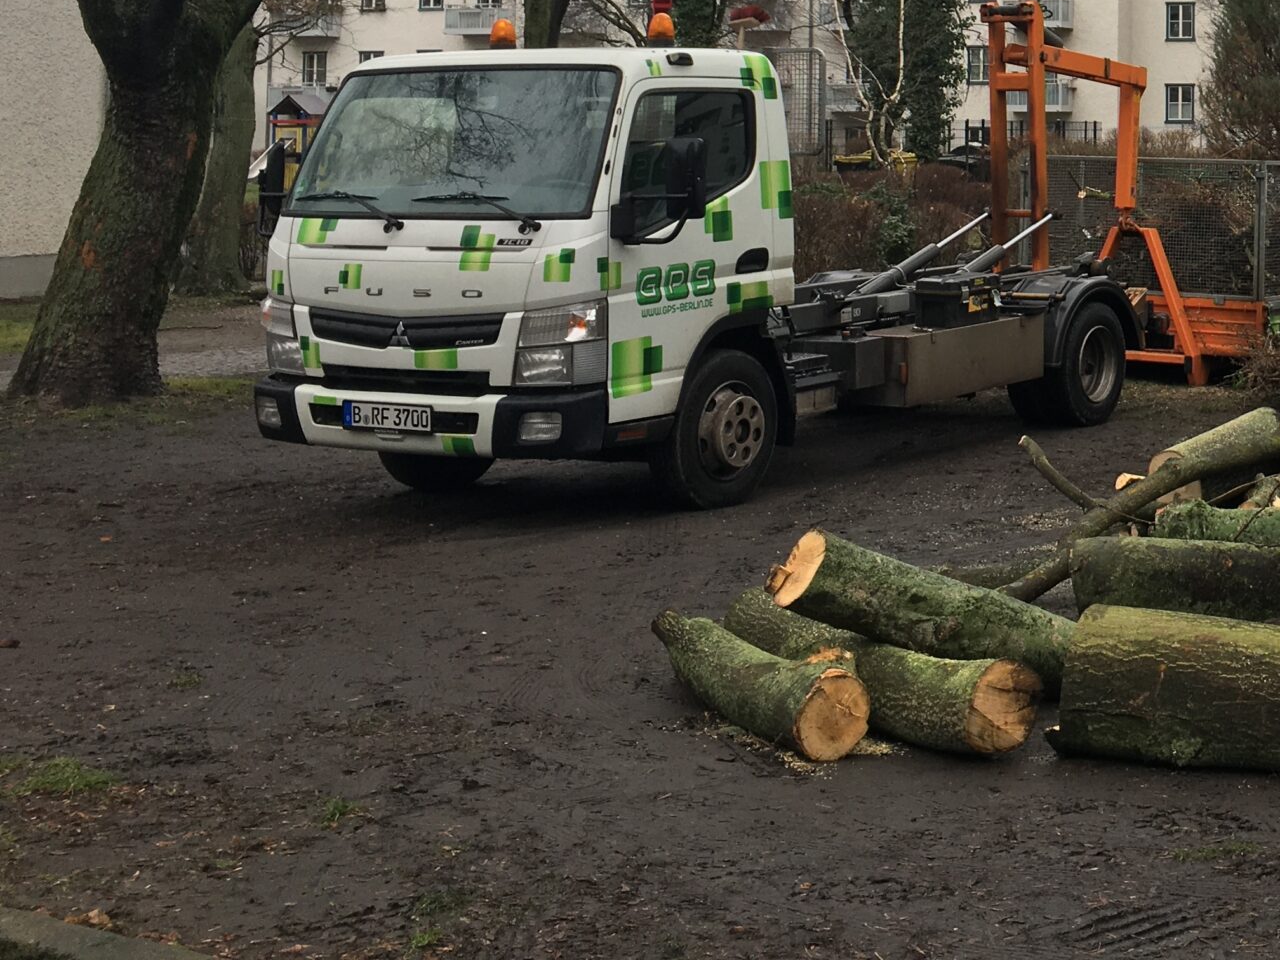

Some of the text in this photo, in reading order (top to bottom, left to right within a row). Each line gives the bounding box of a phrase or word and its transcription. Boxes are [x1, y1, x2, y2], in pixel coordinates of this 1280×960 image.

[324, 286, 482, 299] FUSO
[638, 263, 714, 301] GPS
[352, 405, 430, 429] B RF 3700
